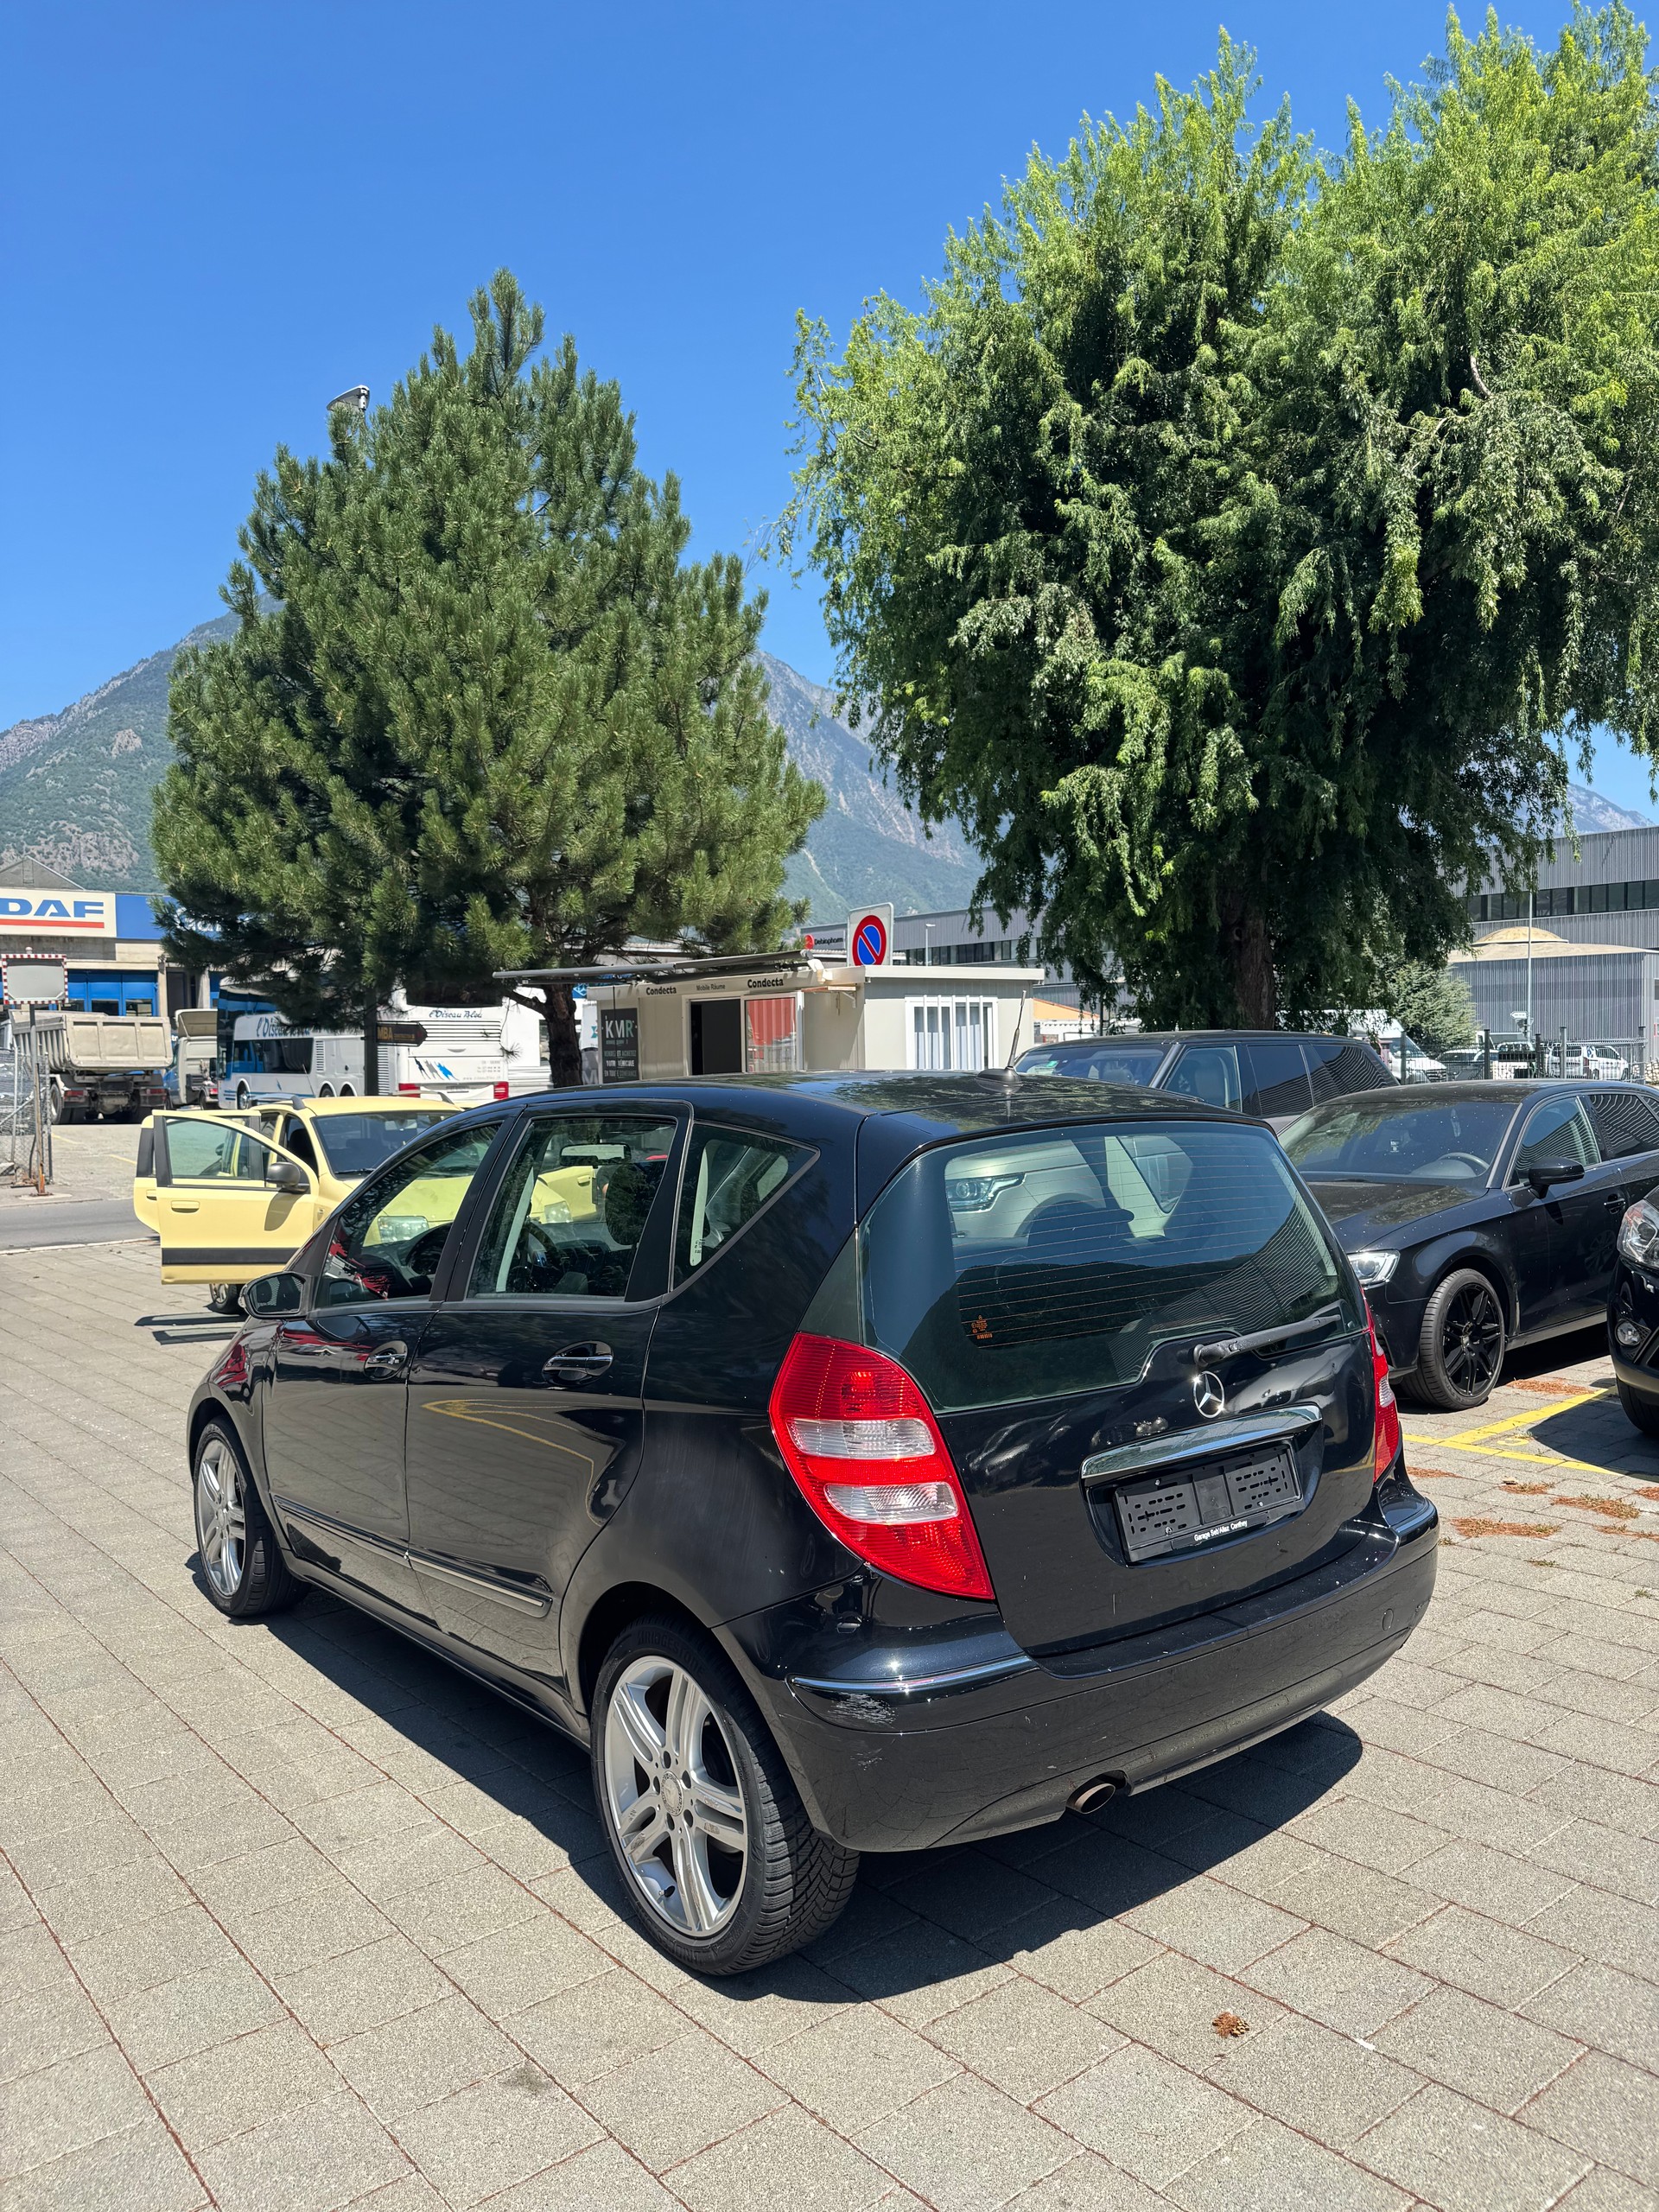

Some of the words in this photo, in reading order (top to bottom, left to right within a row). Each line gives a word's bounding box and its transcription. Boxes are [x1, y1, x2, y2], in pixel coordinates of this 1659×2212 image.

[0, 898, 104, 918] DAF
[645, 986, 677, 995] Condecta
[747, 977, 784, 988] Condecta
[377, 1026, 393, 1040] MBA
[605, 1019, 634, 1039] KMR
[1194, 1532, 1211, 1541] Garage
[1230, 1520, 1248, 1530] Conthey
